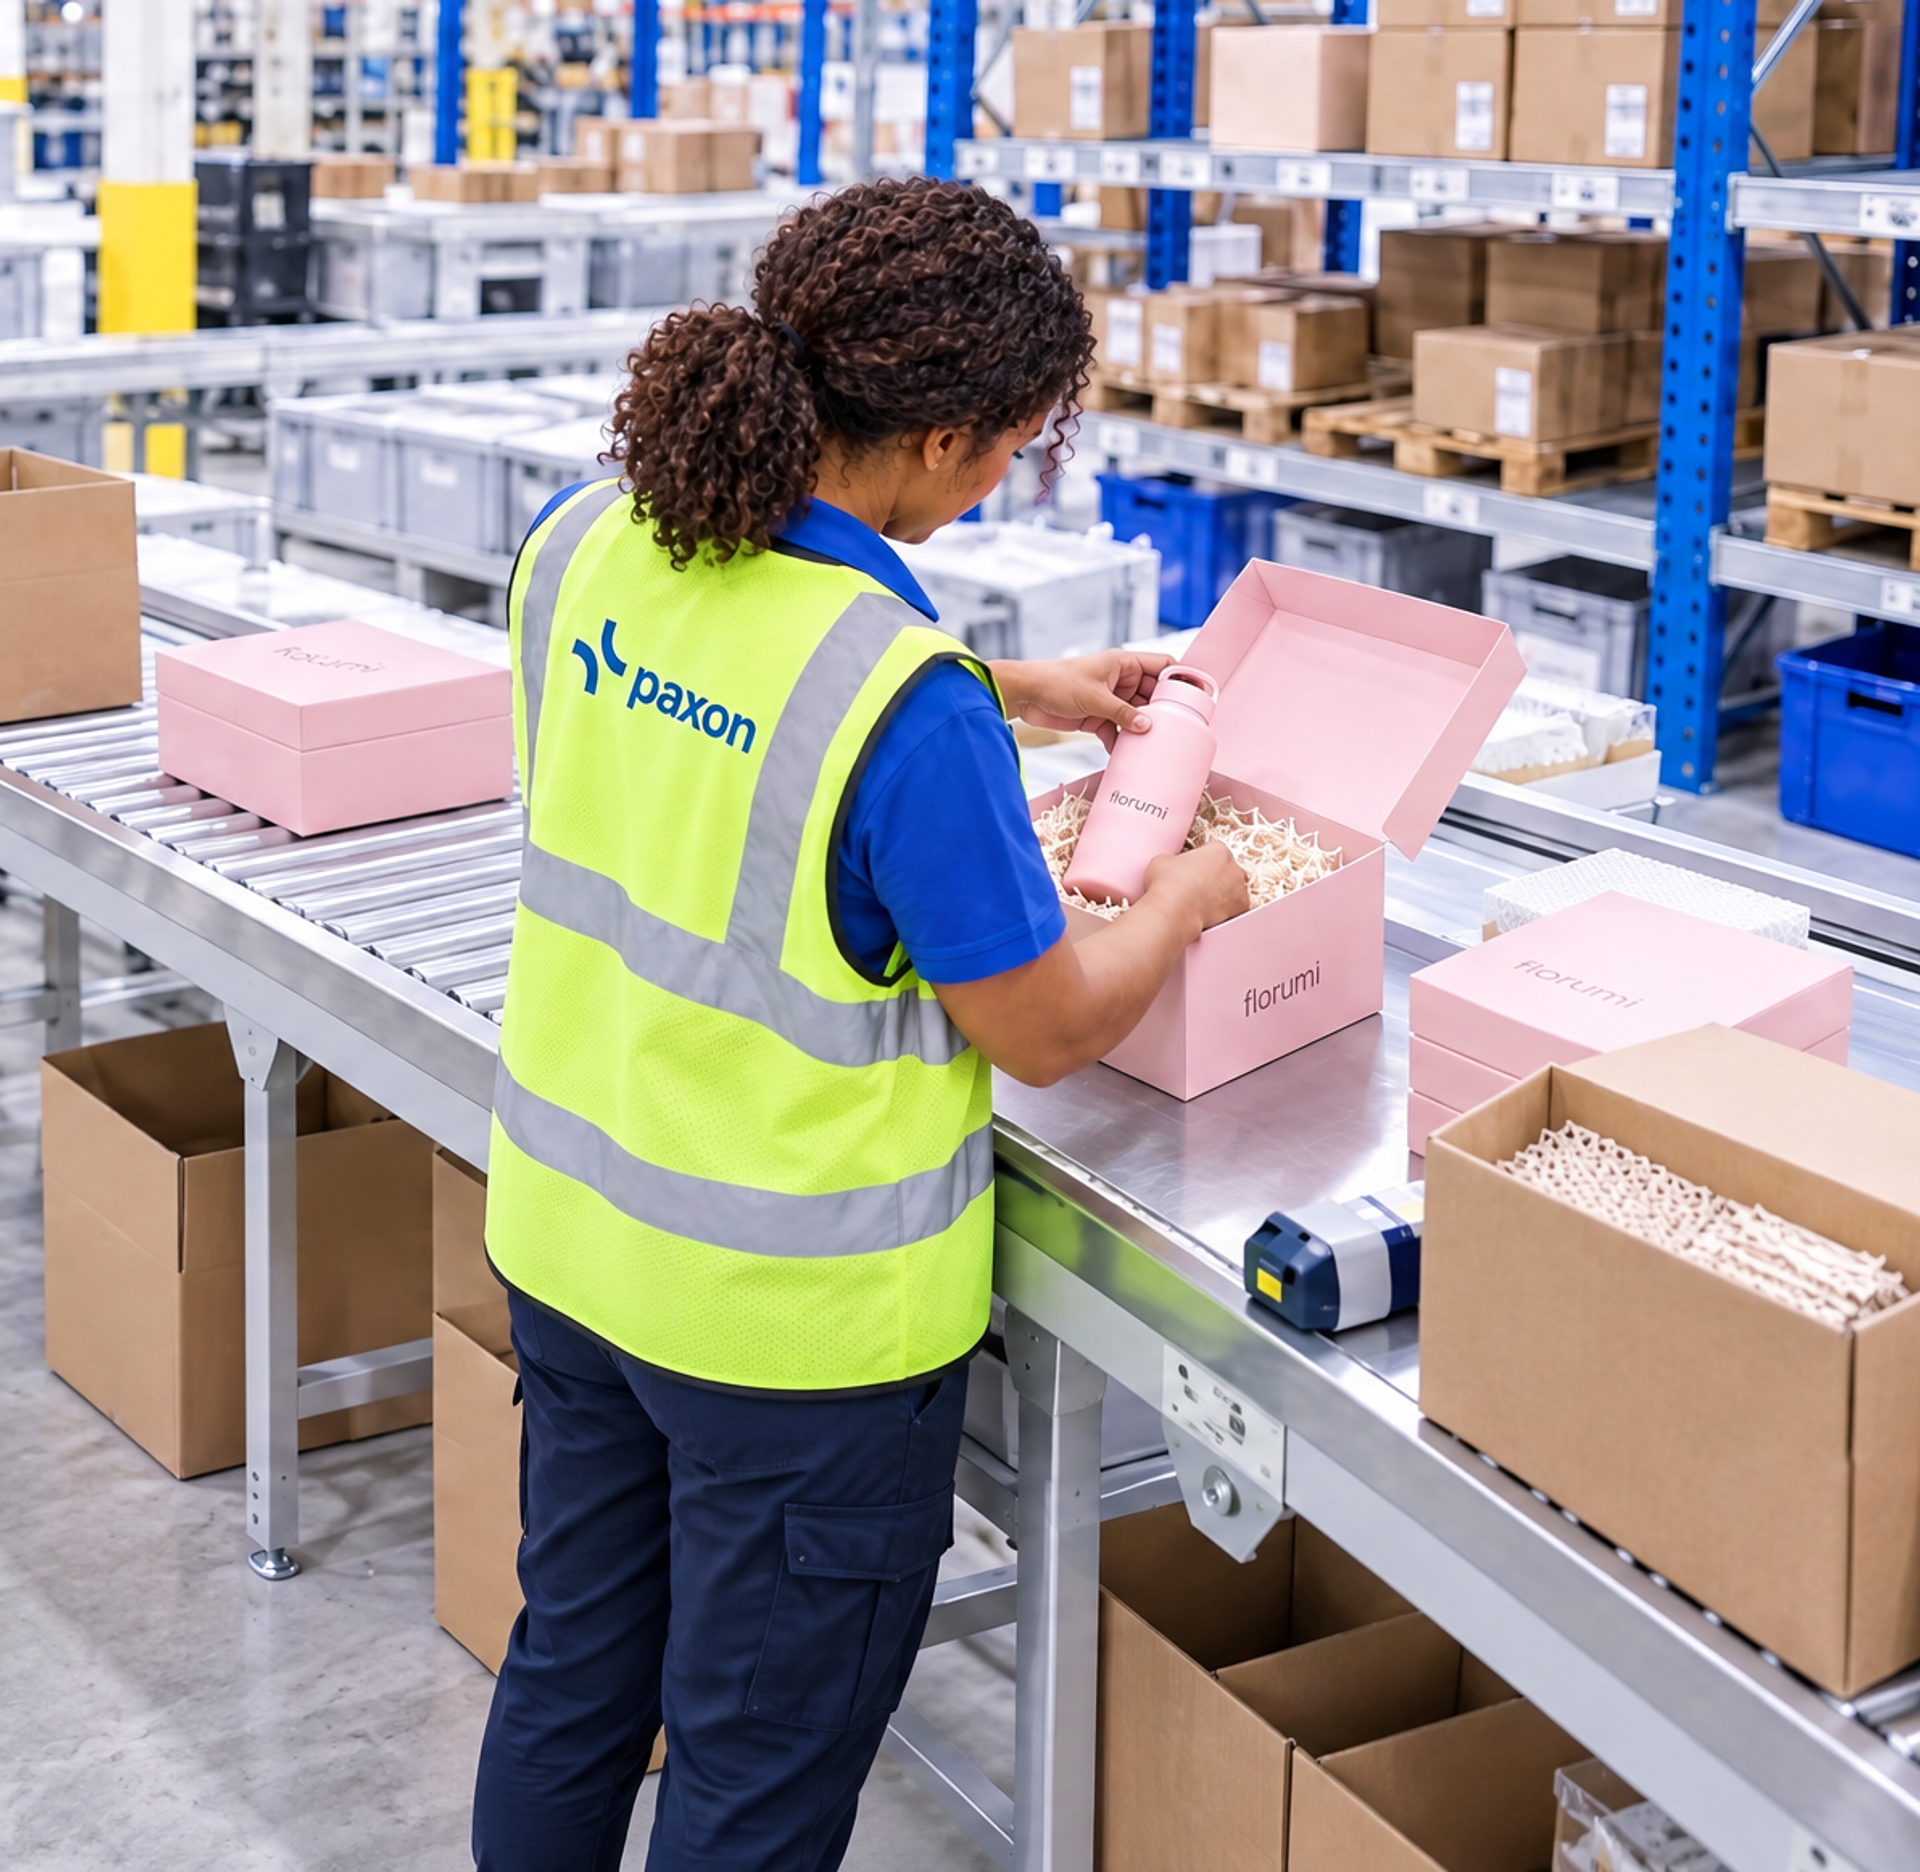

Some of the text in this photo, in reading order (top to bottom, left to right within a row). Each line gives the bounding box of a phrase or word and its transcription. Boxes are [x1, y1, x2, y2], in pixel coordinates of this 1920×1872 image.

[627, 666, 756, 754] paxon
[1109, 789, 1169, 821] florumi
[1244, 960, 1320, 1017] florumi
[1513, 960, 1644, 1009] florumi
